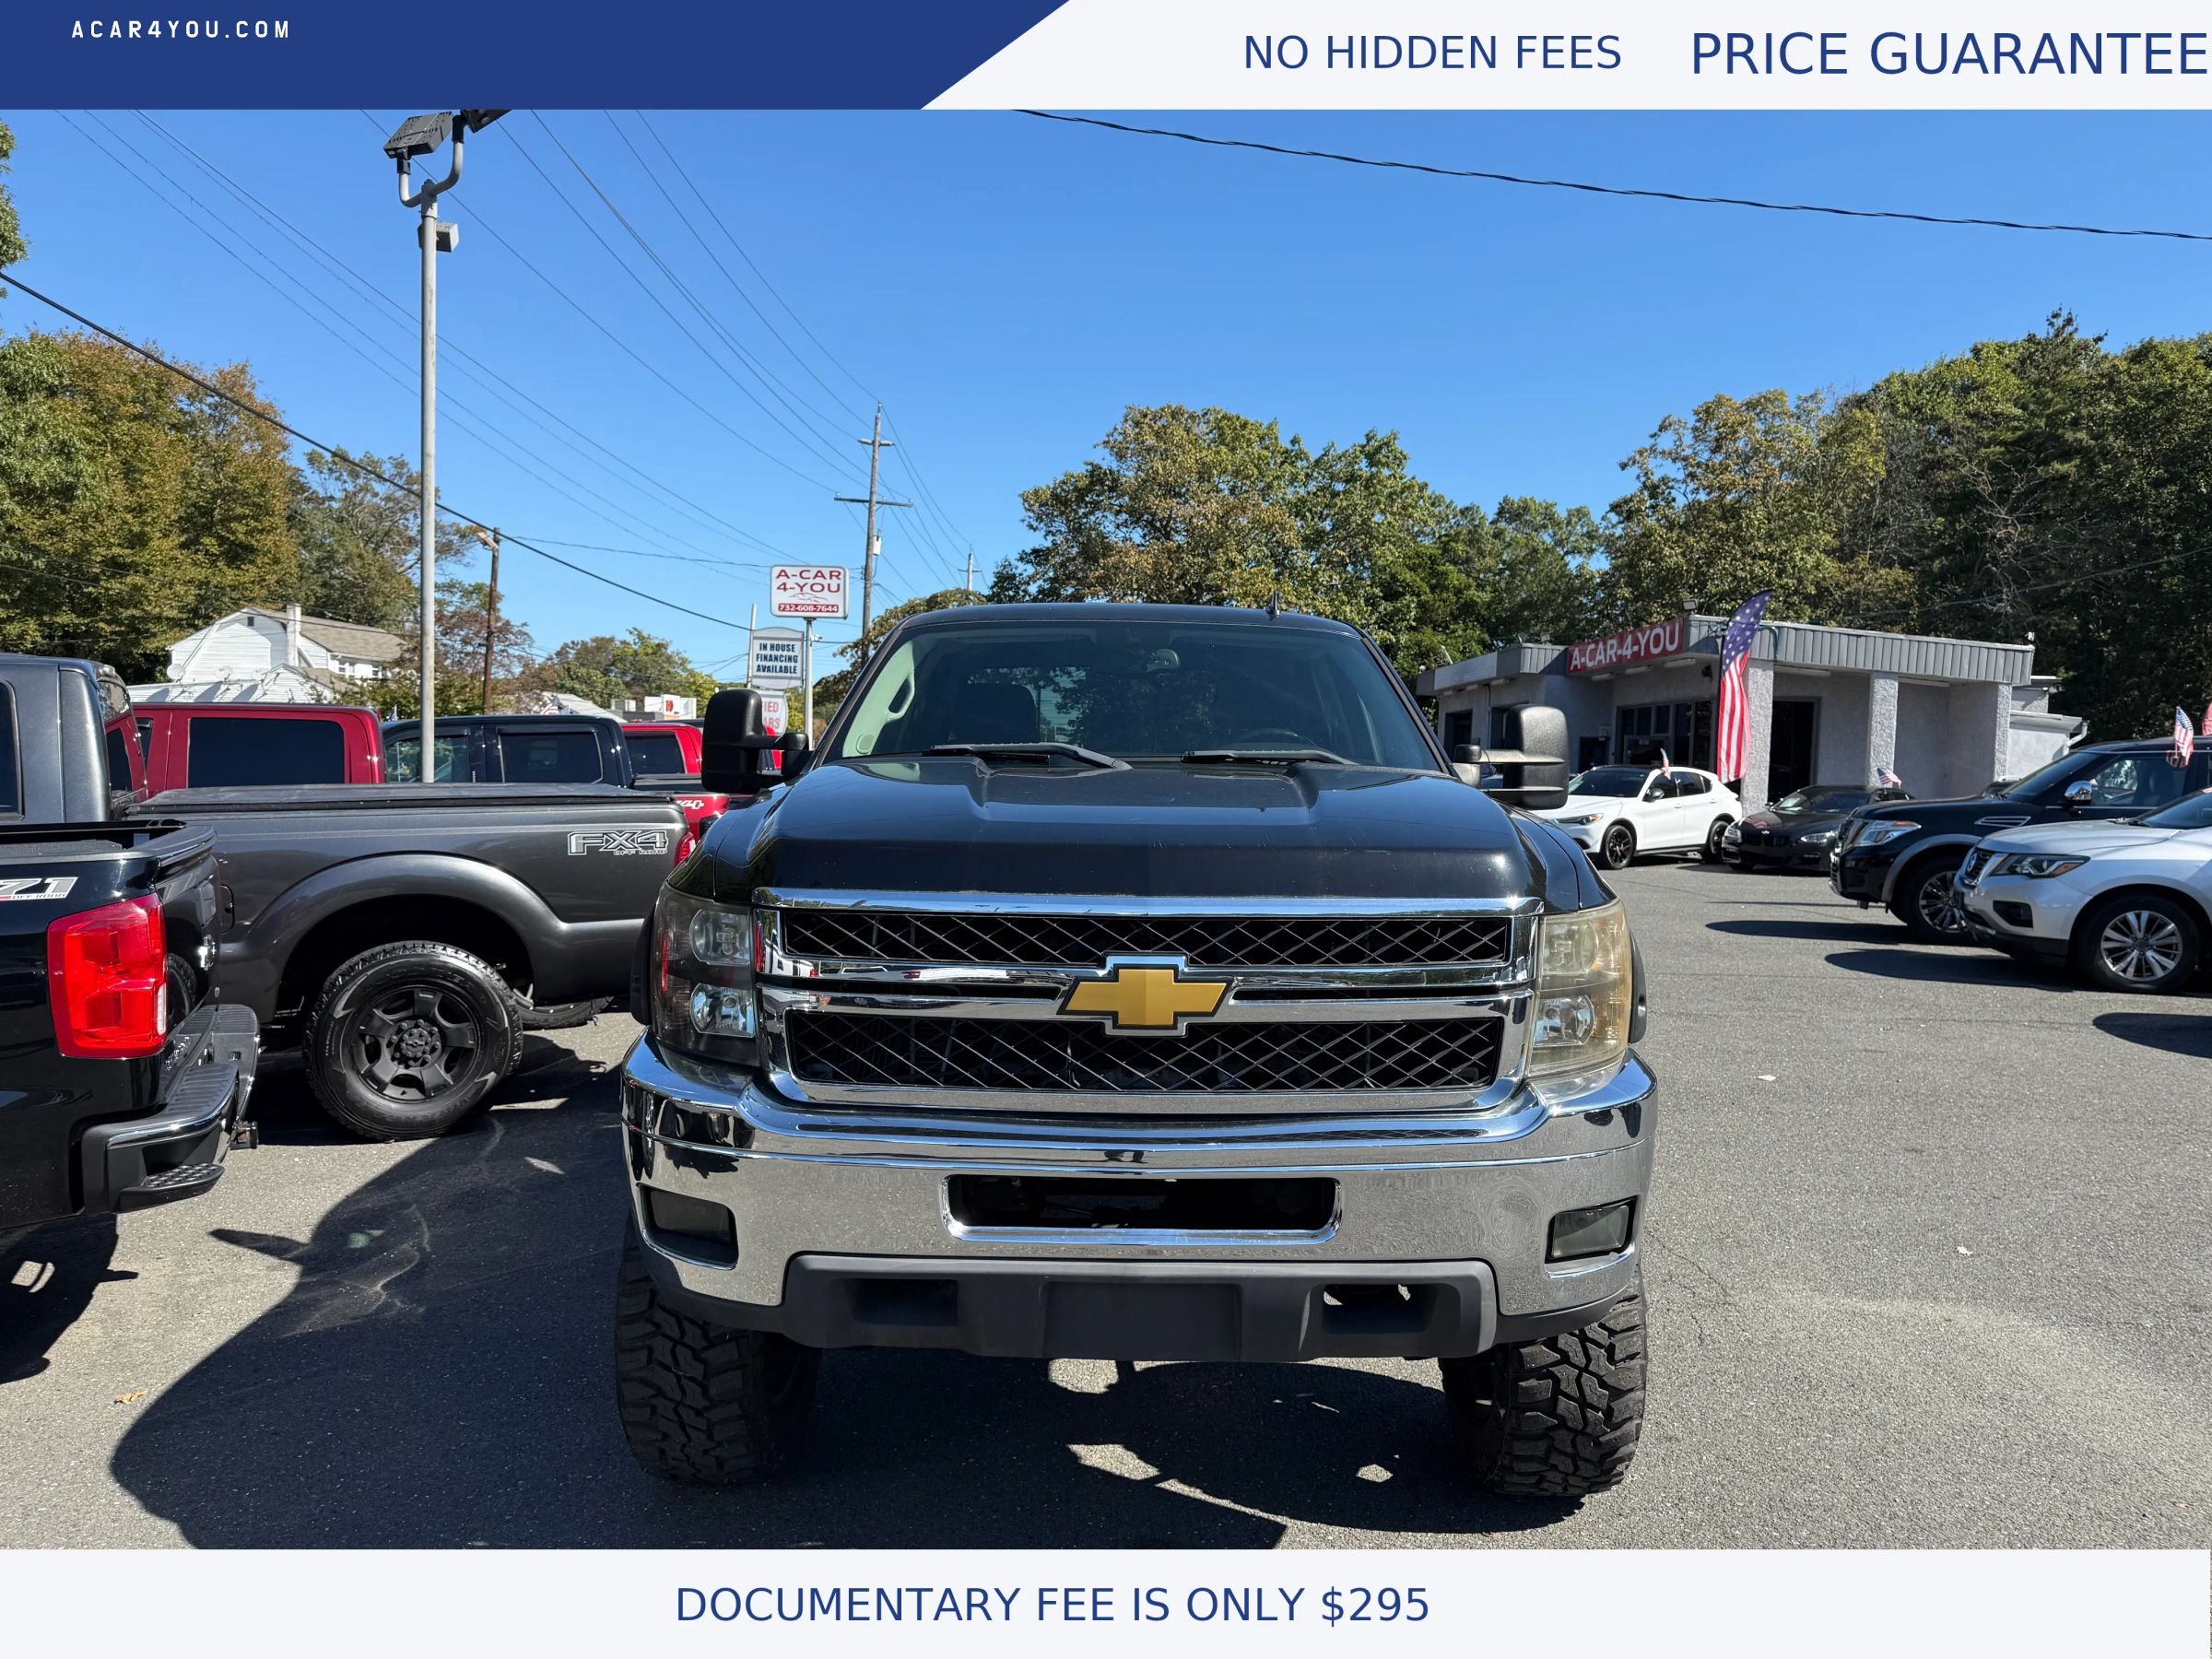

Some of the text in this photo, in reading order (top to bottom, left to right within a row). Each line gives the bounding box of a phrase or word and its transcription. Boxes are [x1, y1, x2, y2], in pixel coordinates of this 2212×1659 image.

[776, 569, 841, 581] A-CAR
[776, 582, 841, 594] 4-YOU
[759, 642, 796, 653] IN HOUSE
[1570, 622, 1680, 671] A-CAR-4-YOU
[756, 653, 799, 664] FINANCING
[756, 664, 798, 675] AVAILABLE
[568, 830, 669, 856] FX4
